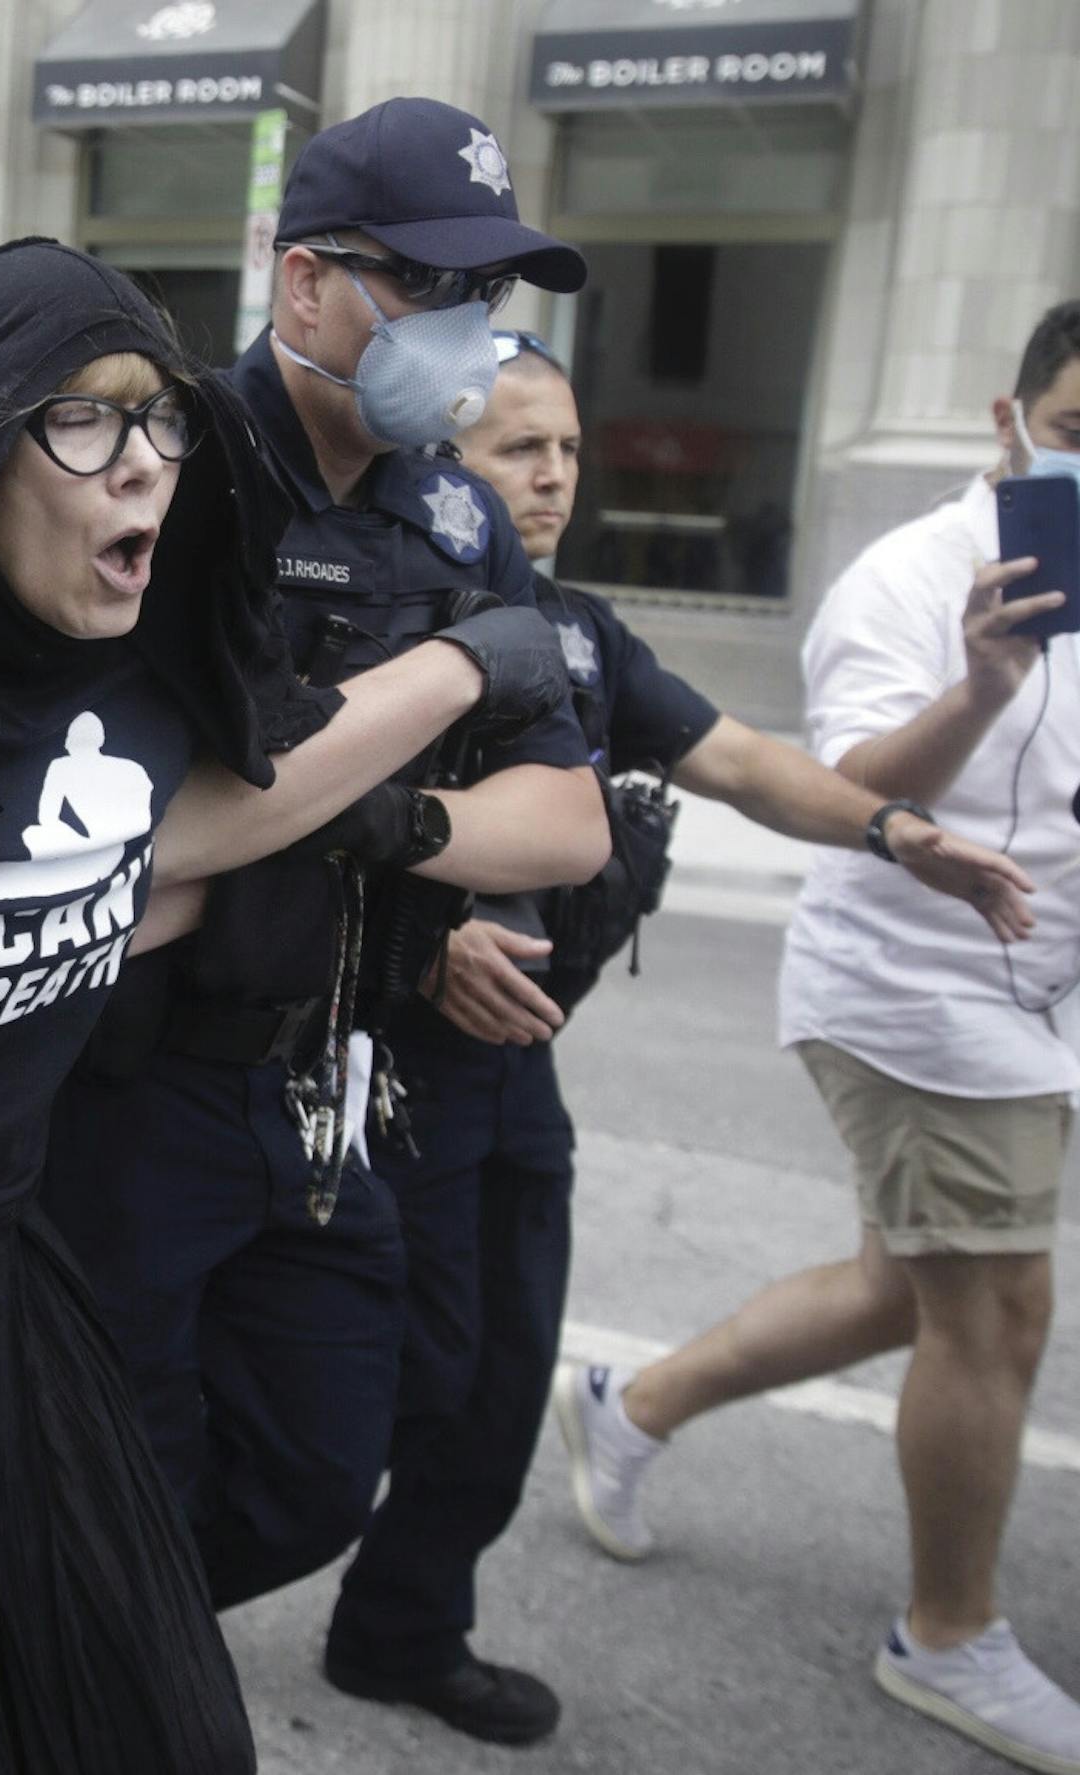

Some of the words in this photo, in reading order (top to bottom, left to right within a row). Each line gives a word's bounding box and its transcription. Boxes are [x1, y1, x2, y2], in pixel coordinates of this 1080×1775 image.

[587, 55, 711, 88] BOILER
[714, 50, 828, 84] ROOM
[76, 80, 172, 108] BOILER
[175, 75, 263, 103] ROOM
